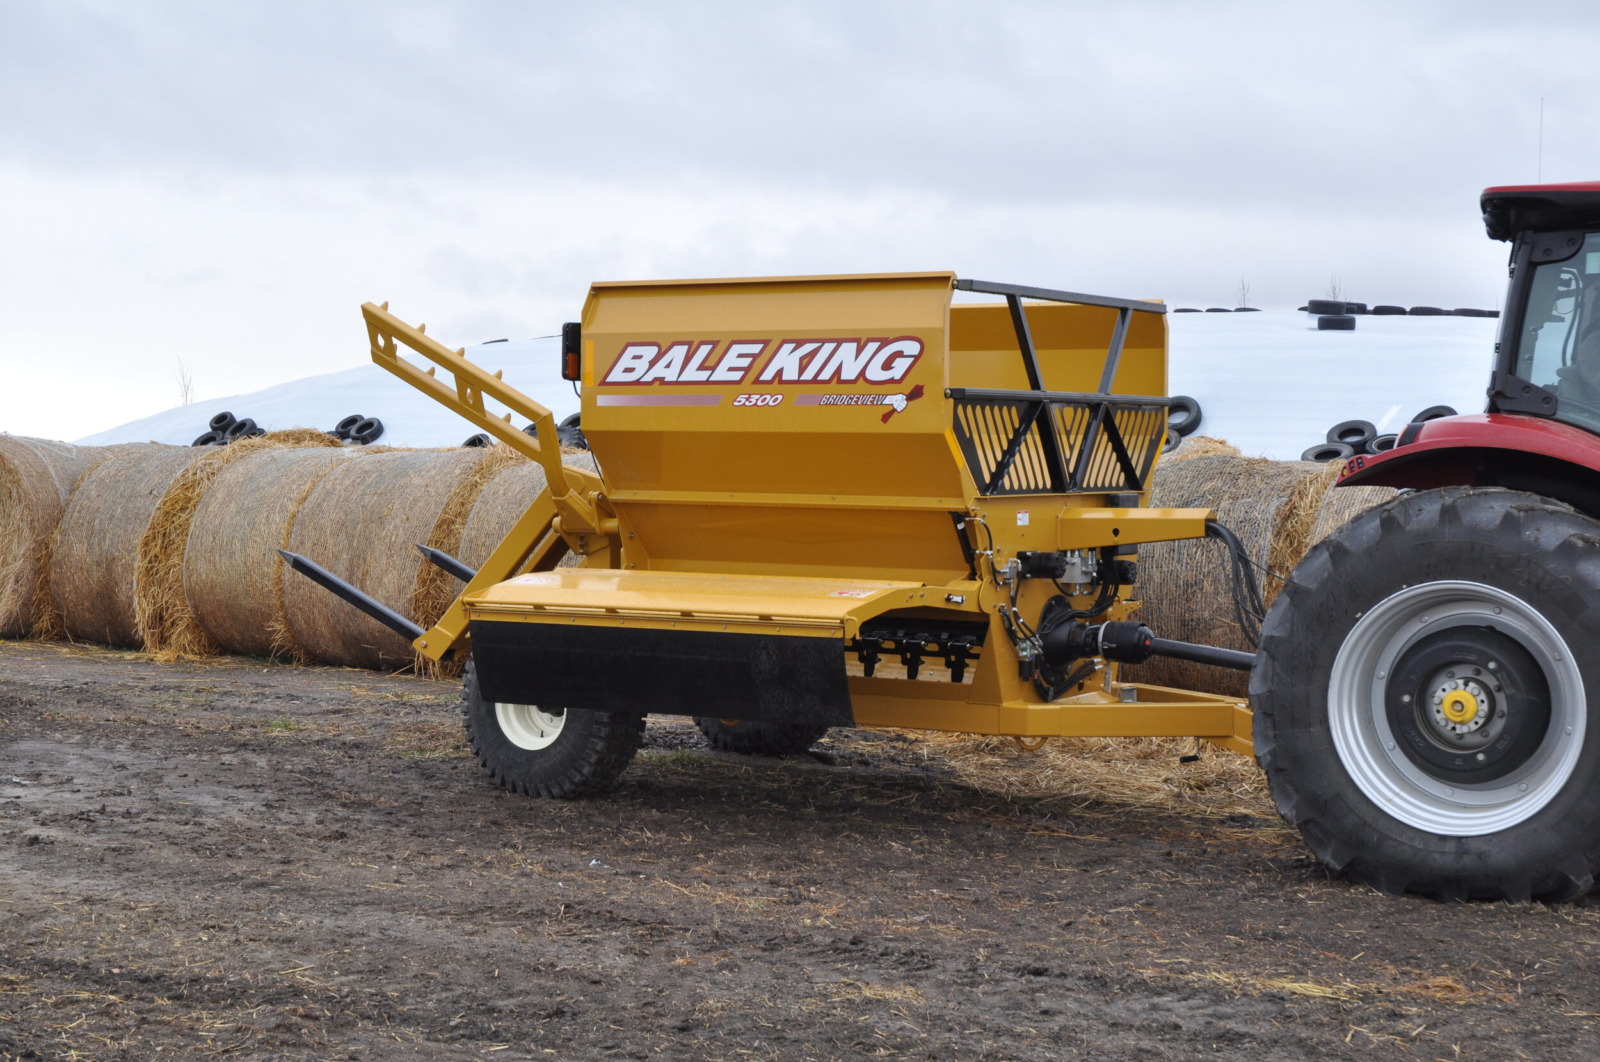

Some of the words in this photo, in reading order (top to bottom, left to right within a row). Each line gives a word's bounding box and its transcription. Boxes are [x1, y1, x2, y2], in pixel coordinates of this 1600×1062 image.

[601, 341, 768, 384] BALE
[756, 338, 922, 383] KING
[732, 394, 784, 407] 5300
[819, 394, 888, 406] BRIDGEVIEW
